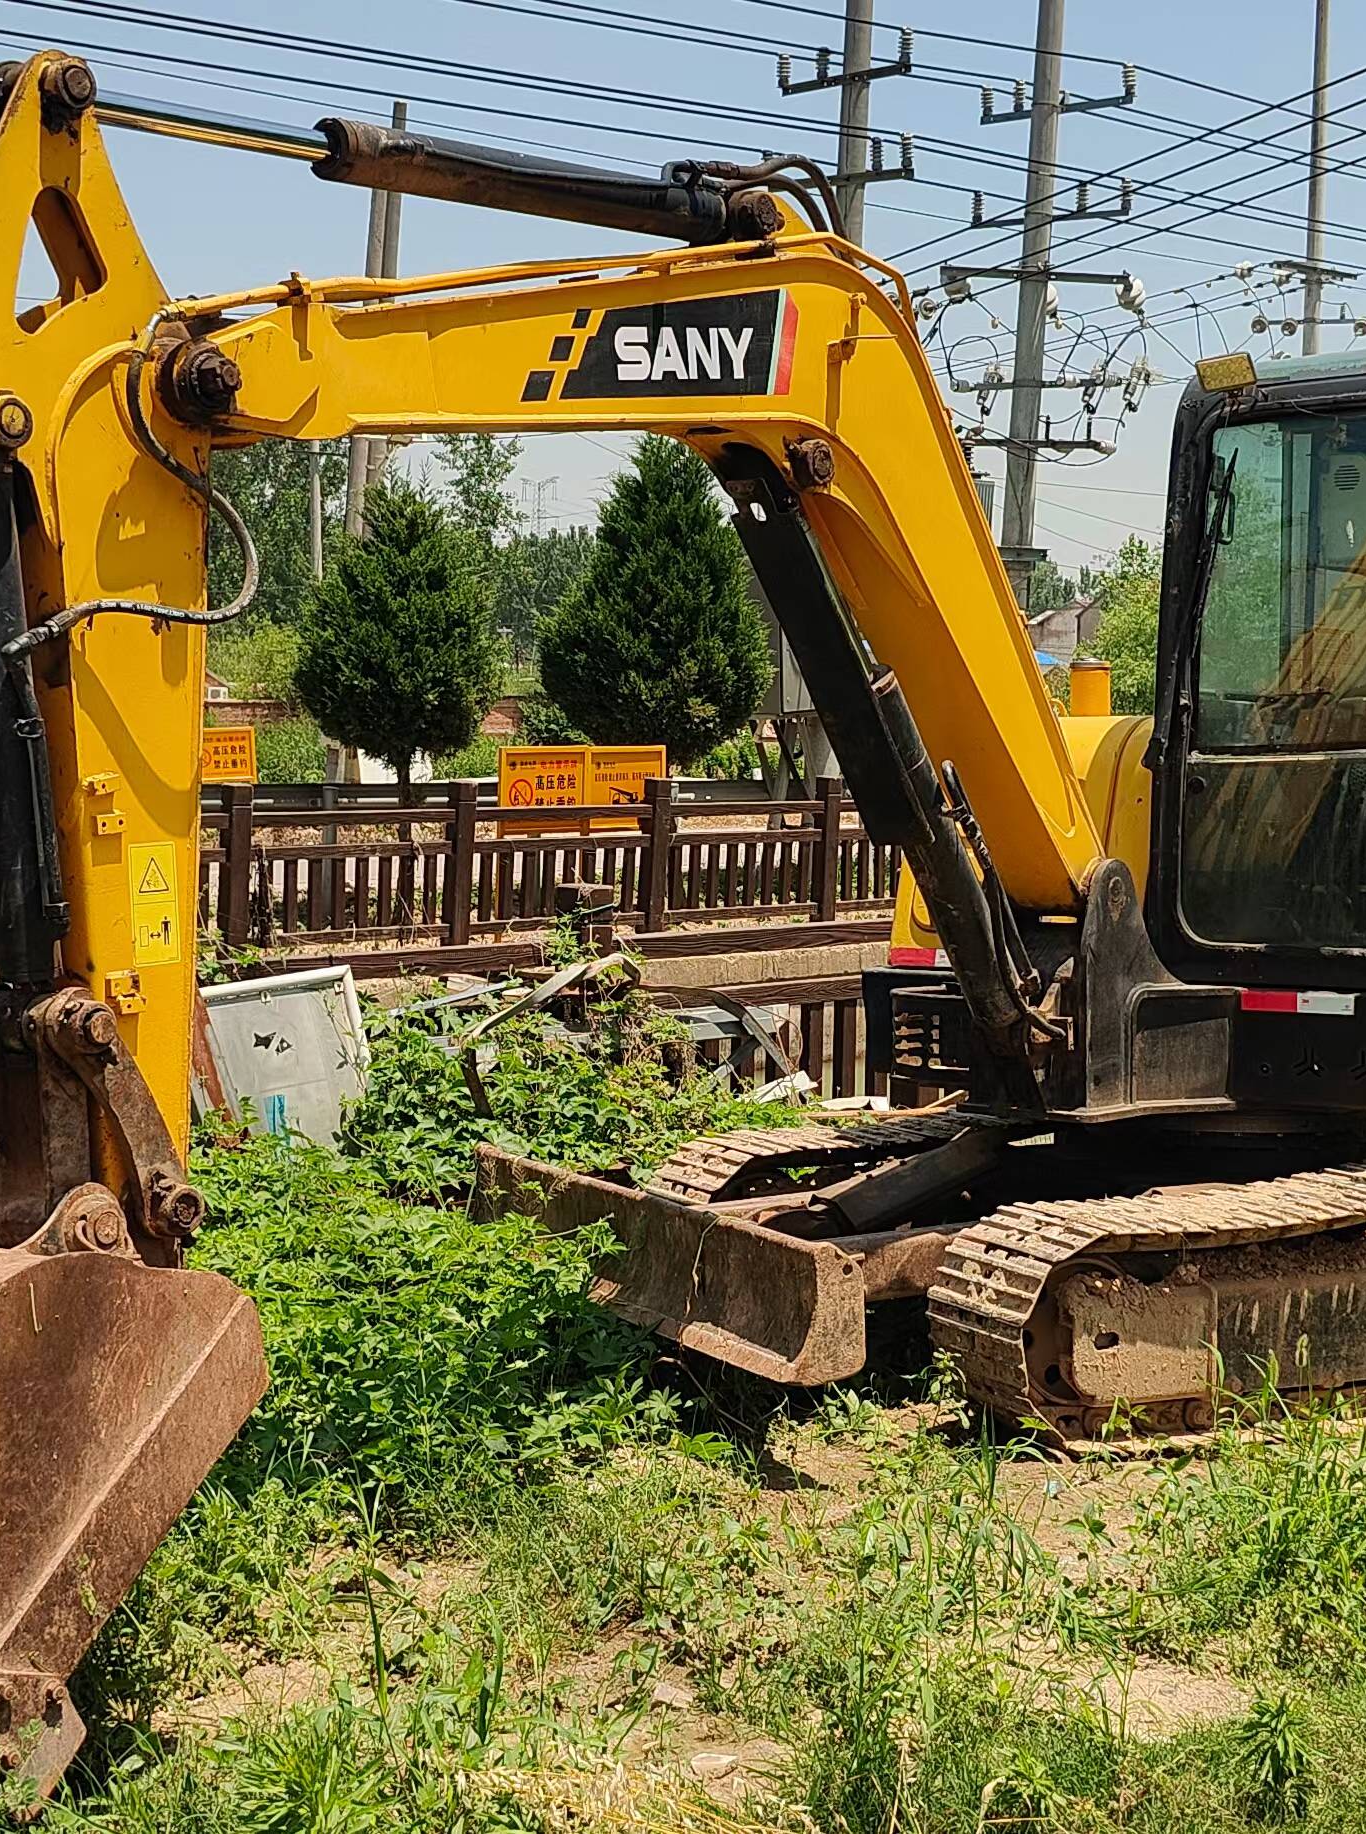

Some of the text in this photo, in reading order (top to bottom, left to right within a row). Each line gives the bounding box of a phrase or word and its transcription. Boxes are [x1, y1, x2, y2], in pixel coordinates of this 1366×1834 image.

[614, 326, 753, 381] SANY
[212, 744, 247, 756] 高压危险
[213, 758, 248, 769] 禁止垂钓
[535, 773, 577, 790] 高压危险
